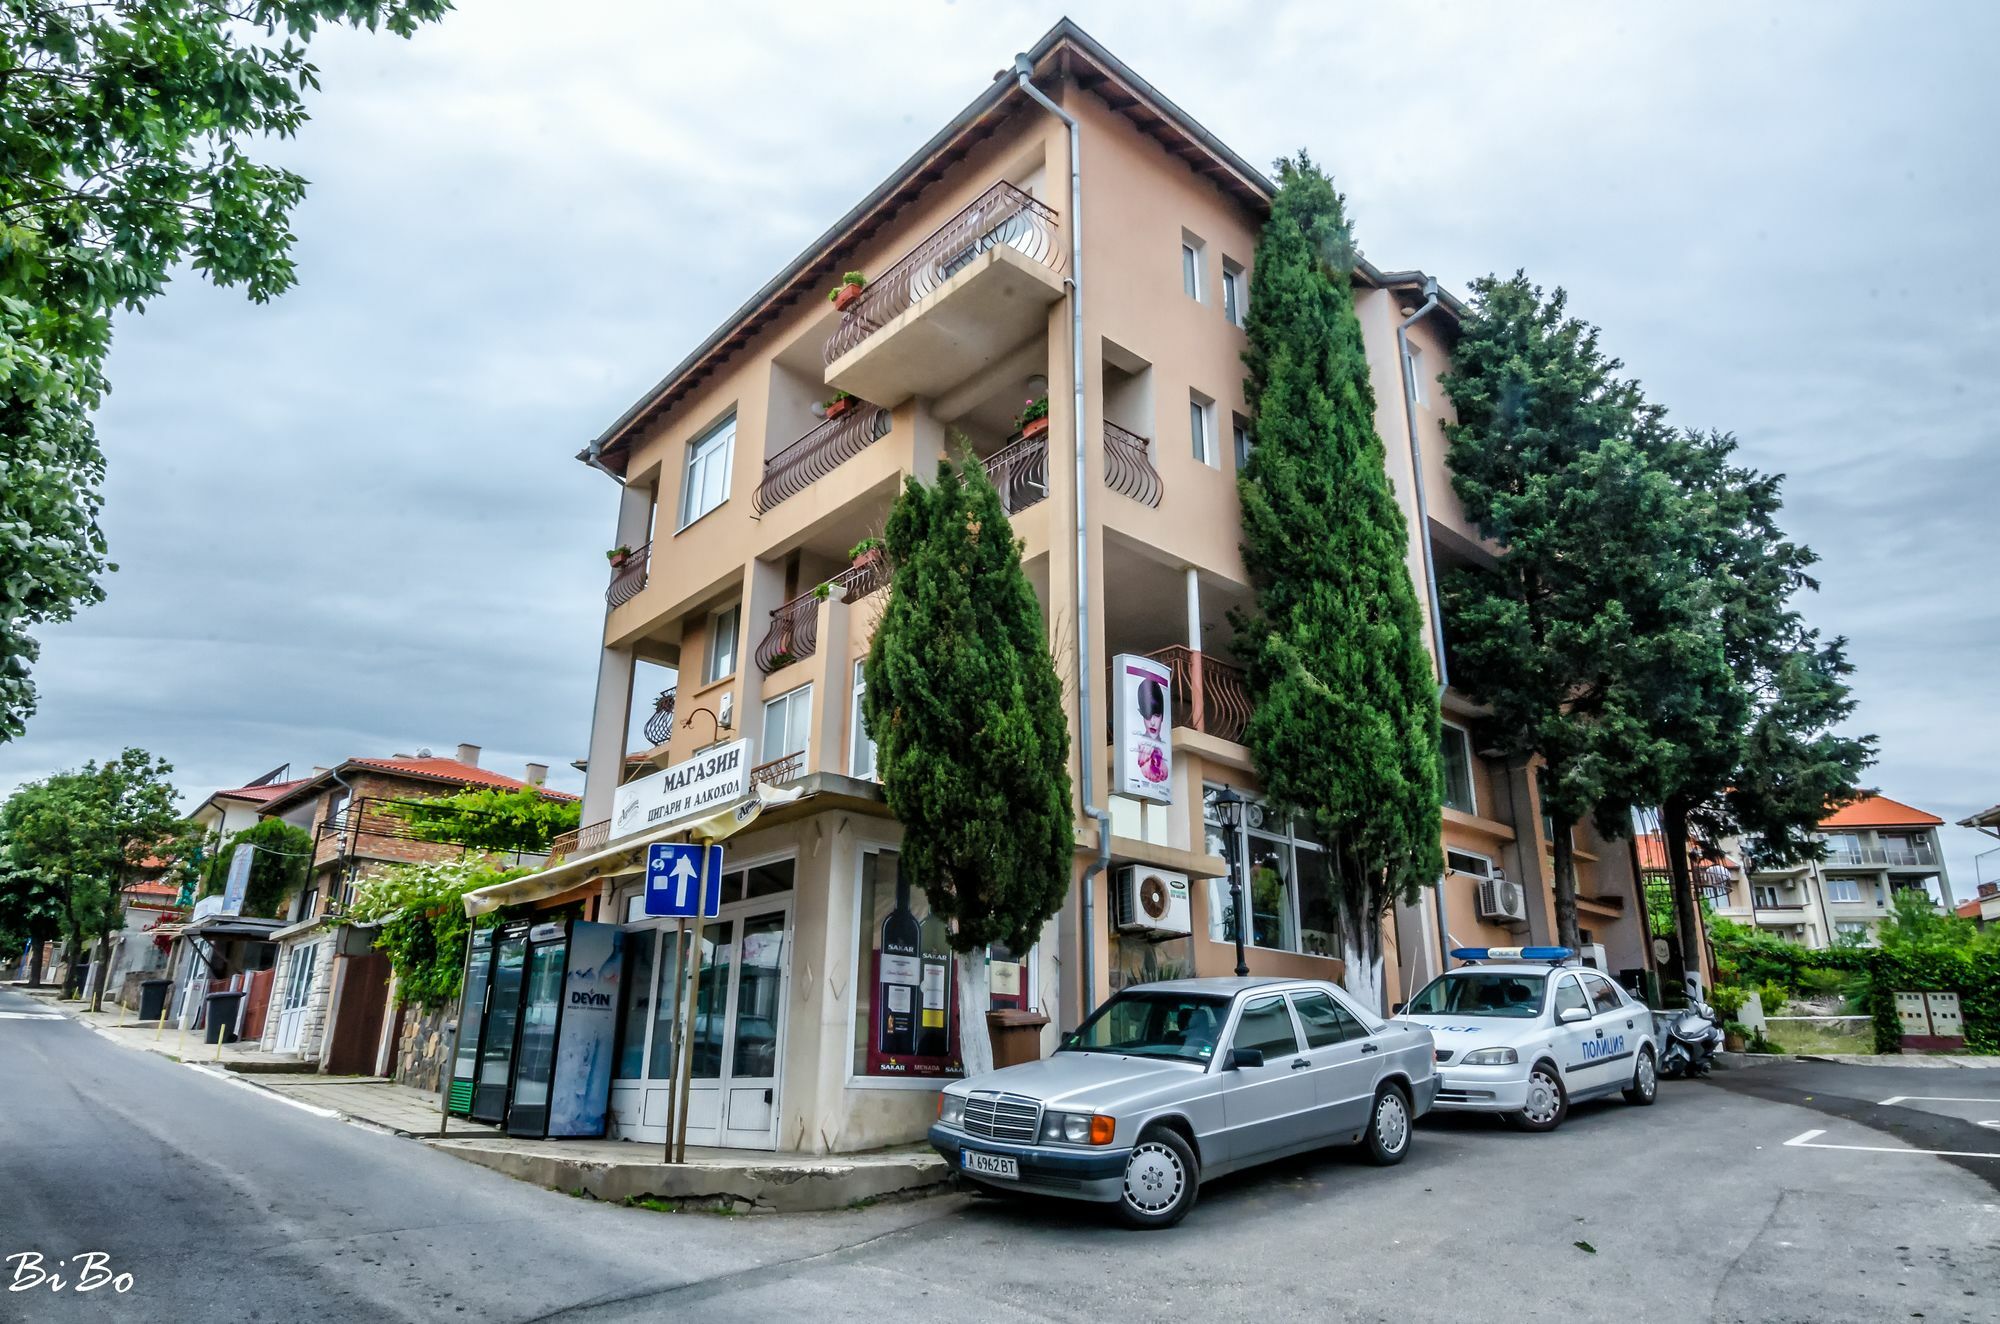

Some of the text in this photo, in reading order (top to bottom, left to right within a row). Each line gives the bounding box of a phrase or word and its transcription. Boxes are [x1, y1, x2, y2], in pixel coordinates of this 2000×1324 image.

[663, 749, 740, 794] МАГАЗИН
[648, 799, 681, 822] ЦИГАРИ
[684, 796, 691, 809] И
[693, 780, 740, 808] АЛКОХОЛ
[888, 944, 914, 953] SAKAR
[922, 952, 948, 961] SAKAR
[571, 990, 610, 1006] DEVIN
[1582, 1035, 1625, 1060] ПОЛИЦИЯ
